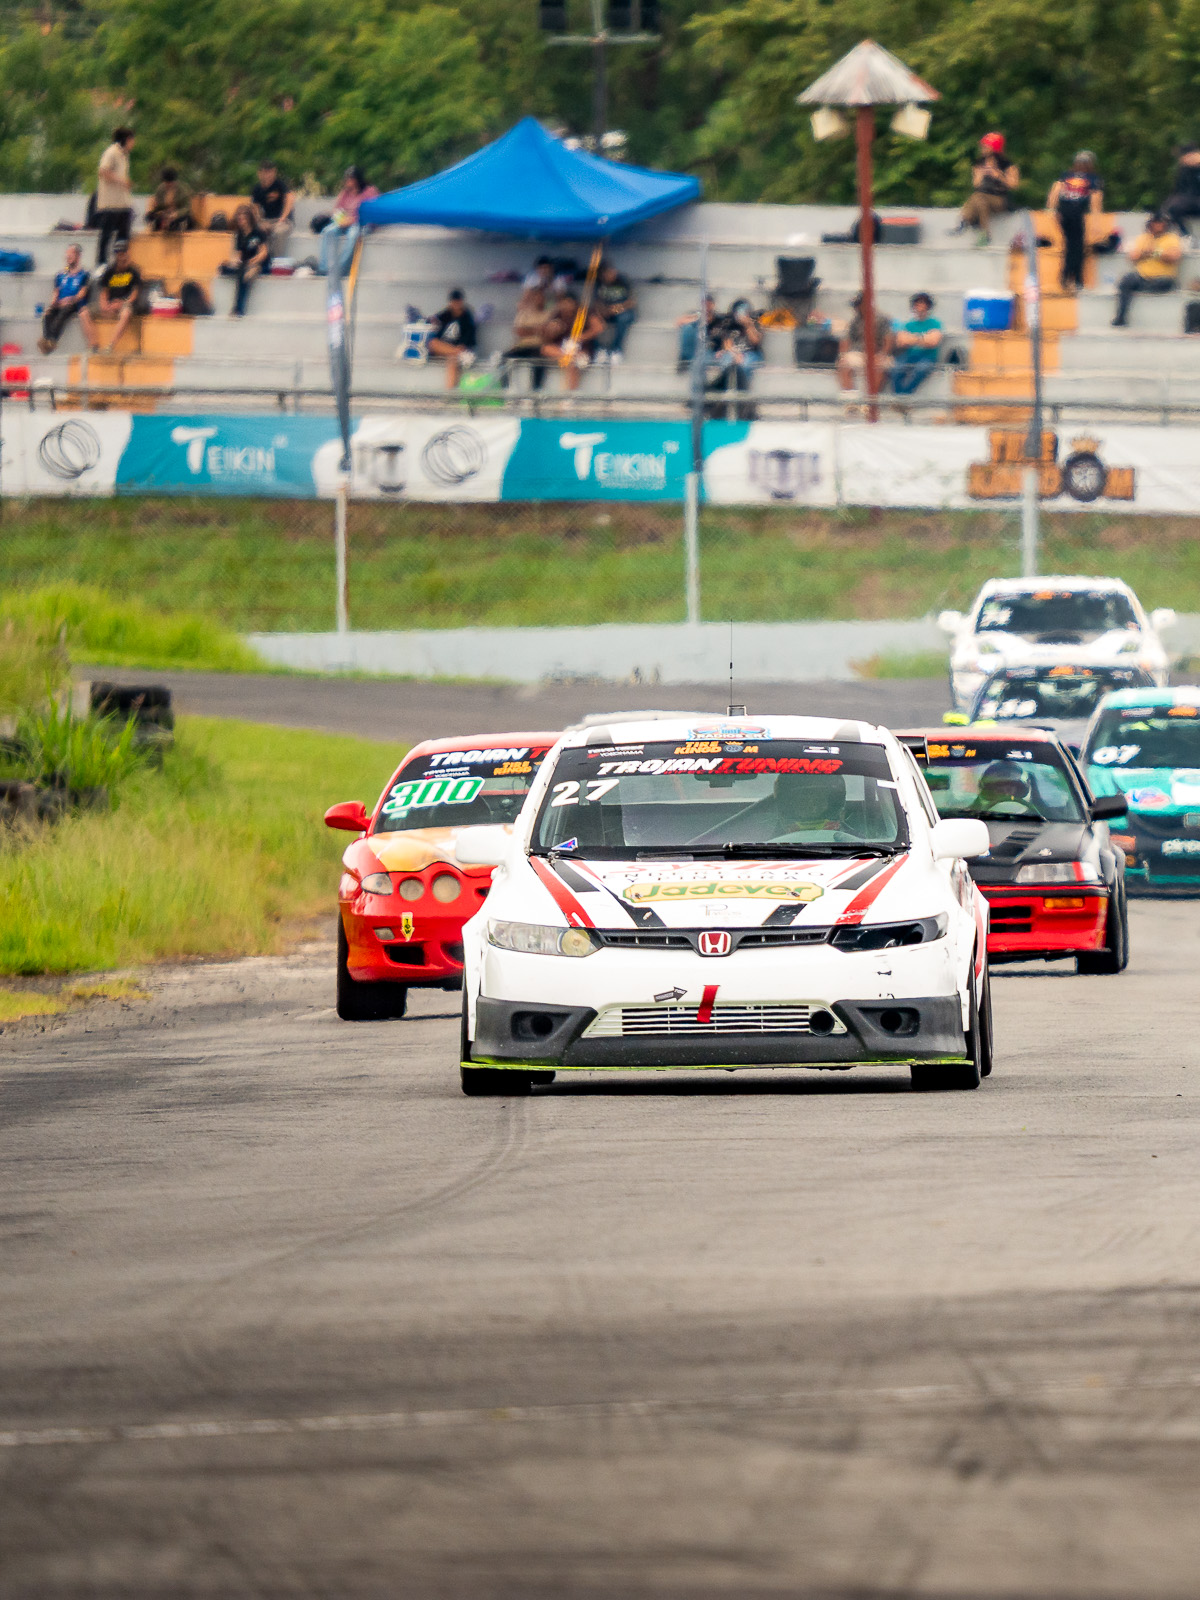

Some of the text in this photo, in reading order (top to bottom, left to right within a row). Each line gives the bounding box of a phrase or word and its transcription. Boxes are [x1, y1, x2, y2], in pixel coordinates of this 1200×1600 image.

[685, 741, 719, 749] TIRE
[382, 776, 485, 814] 300
[551, 778, 620, 808] 27
